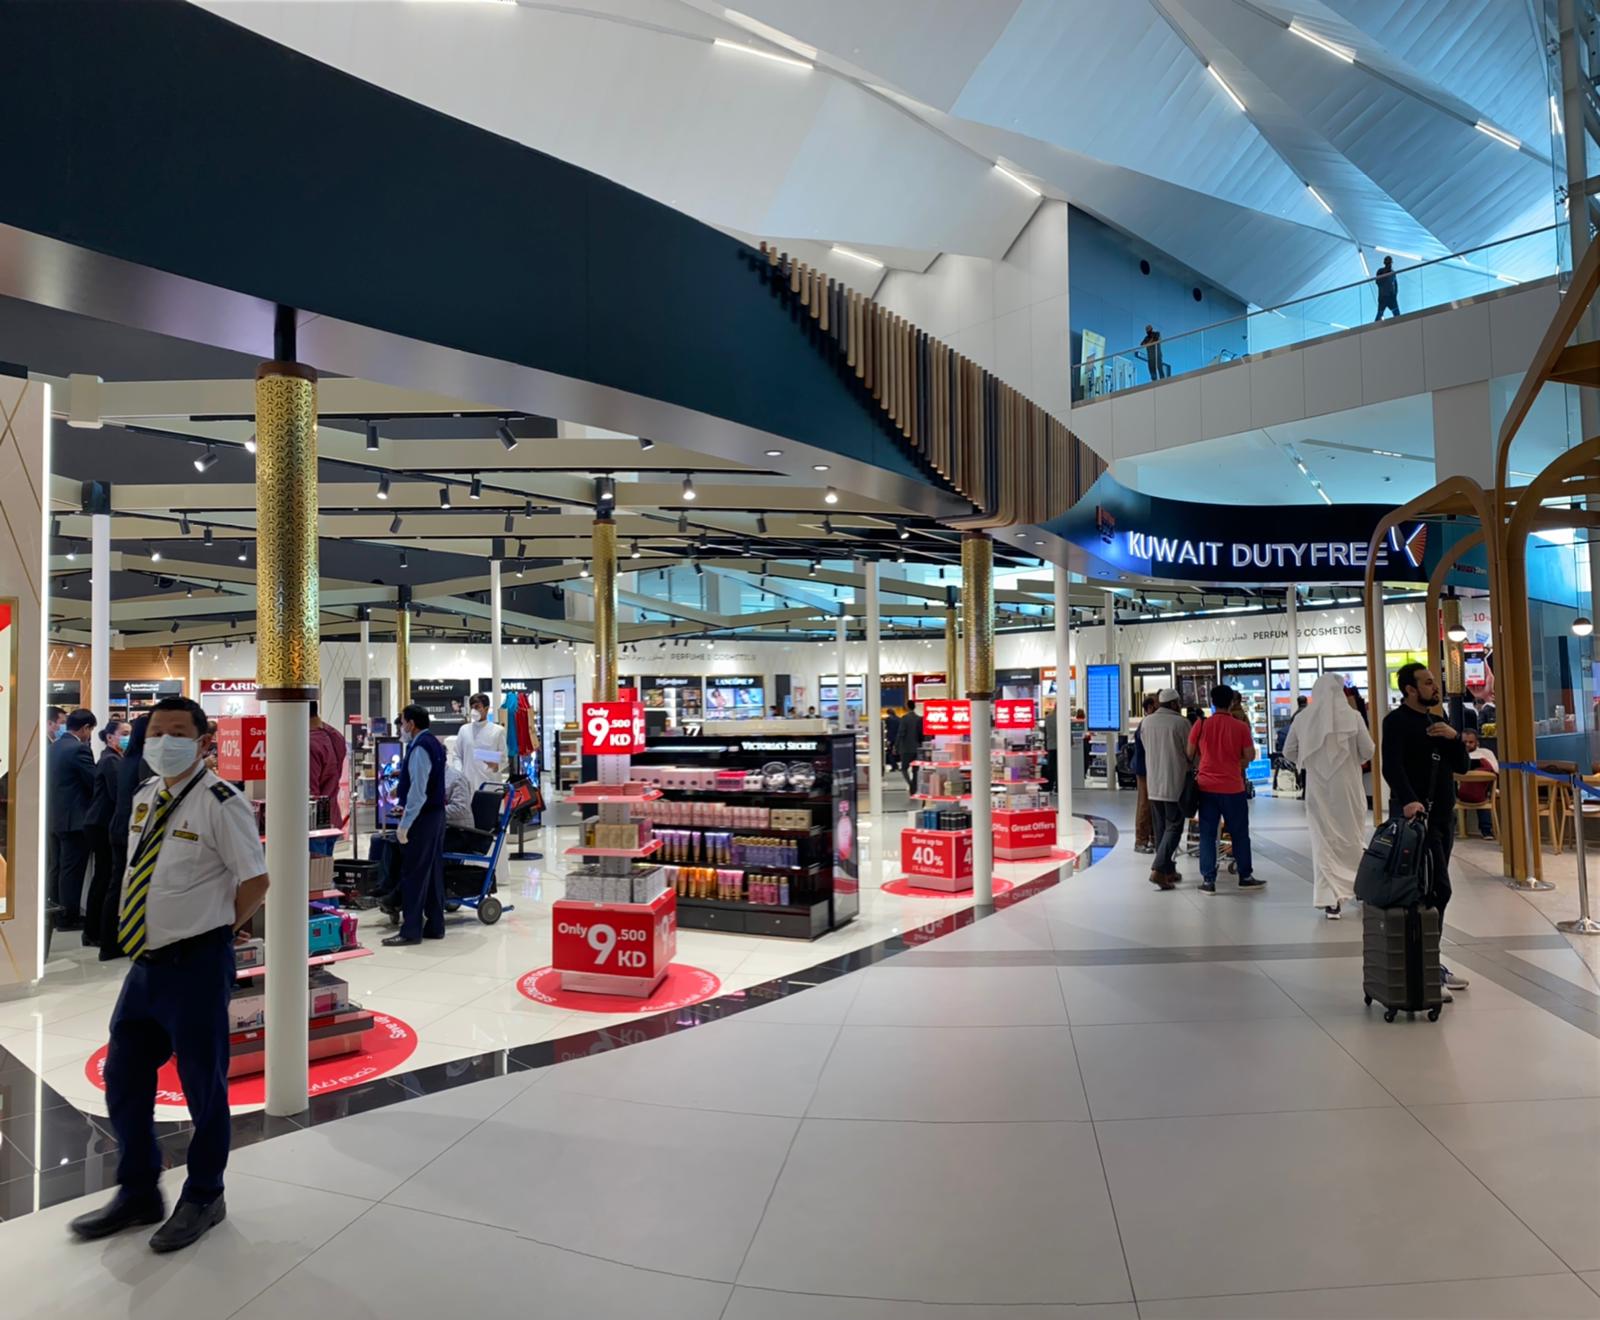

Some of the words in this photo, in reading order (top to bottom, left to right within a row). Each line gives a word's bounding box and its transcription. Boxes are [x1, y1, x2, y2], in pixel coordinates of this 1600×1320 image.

[1129, 530, 1223, 566] KUWAIT
[1232, 542, 1389, 567] DUTYFREE
[1253, 630, 1289, 640] PERFUM
[1303, 625, 1362, 637] COSMETICS
[587, 707, 609, 718] Only
[587, 717, 610, 746] 9
[609, 719, 631, 728] .500
[609, 734, 631, 746] KD
[786, 741, 818, 750] SECRET
[221, 740, 241, 757] 40%
[1011, 824, 1032, 832] Great
[1032, 821, 1055, 831] Offers
[911, 836, 926, 844] Save
[911, 846, 944, 866] 40%
[558, 922, 588, 938] Only
[587, 924, 617, 965] 9
[617, 929, 647, 942] .500
[617, 950, 647, 968] KD
